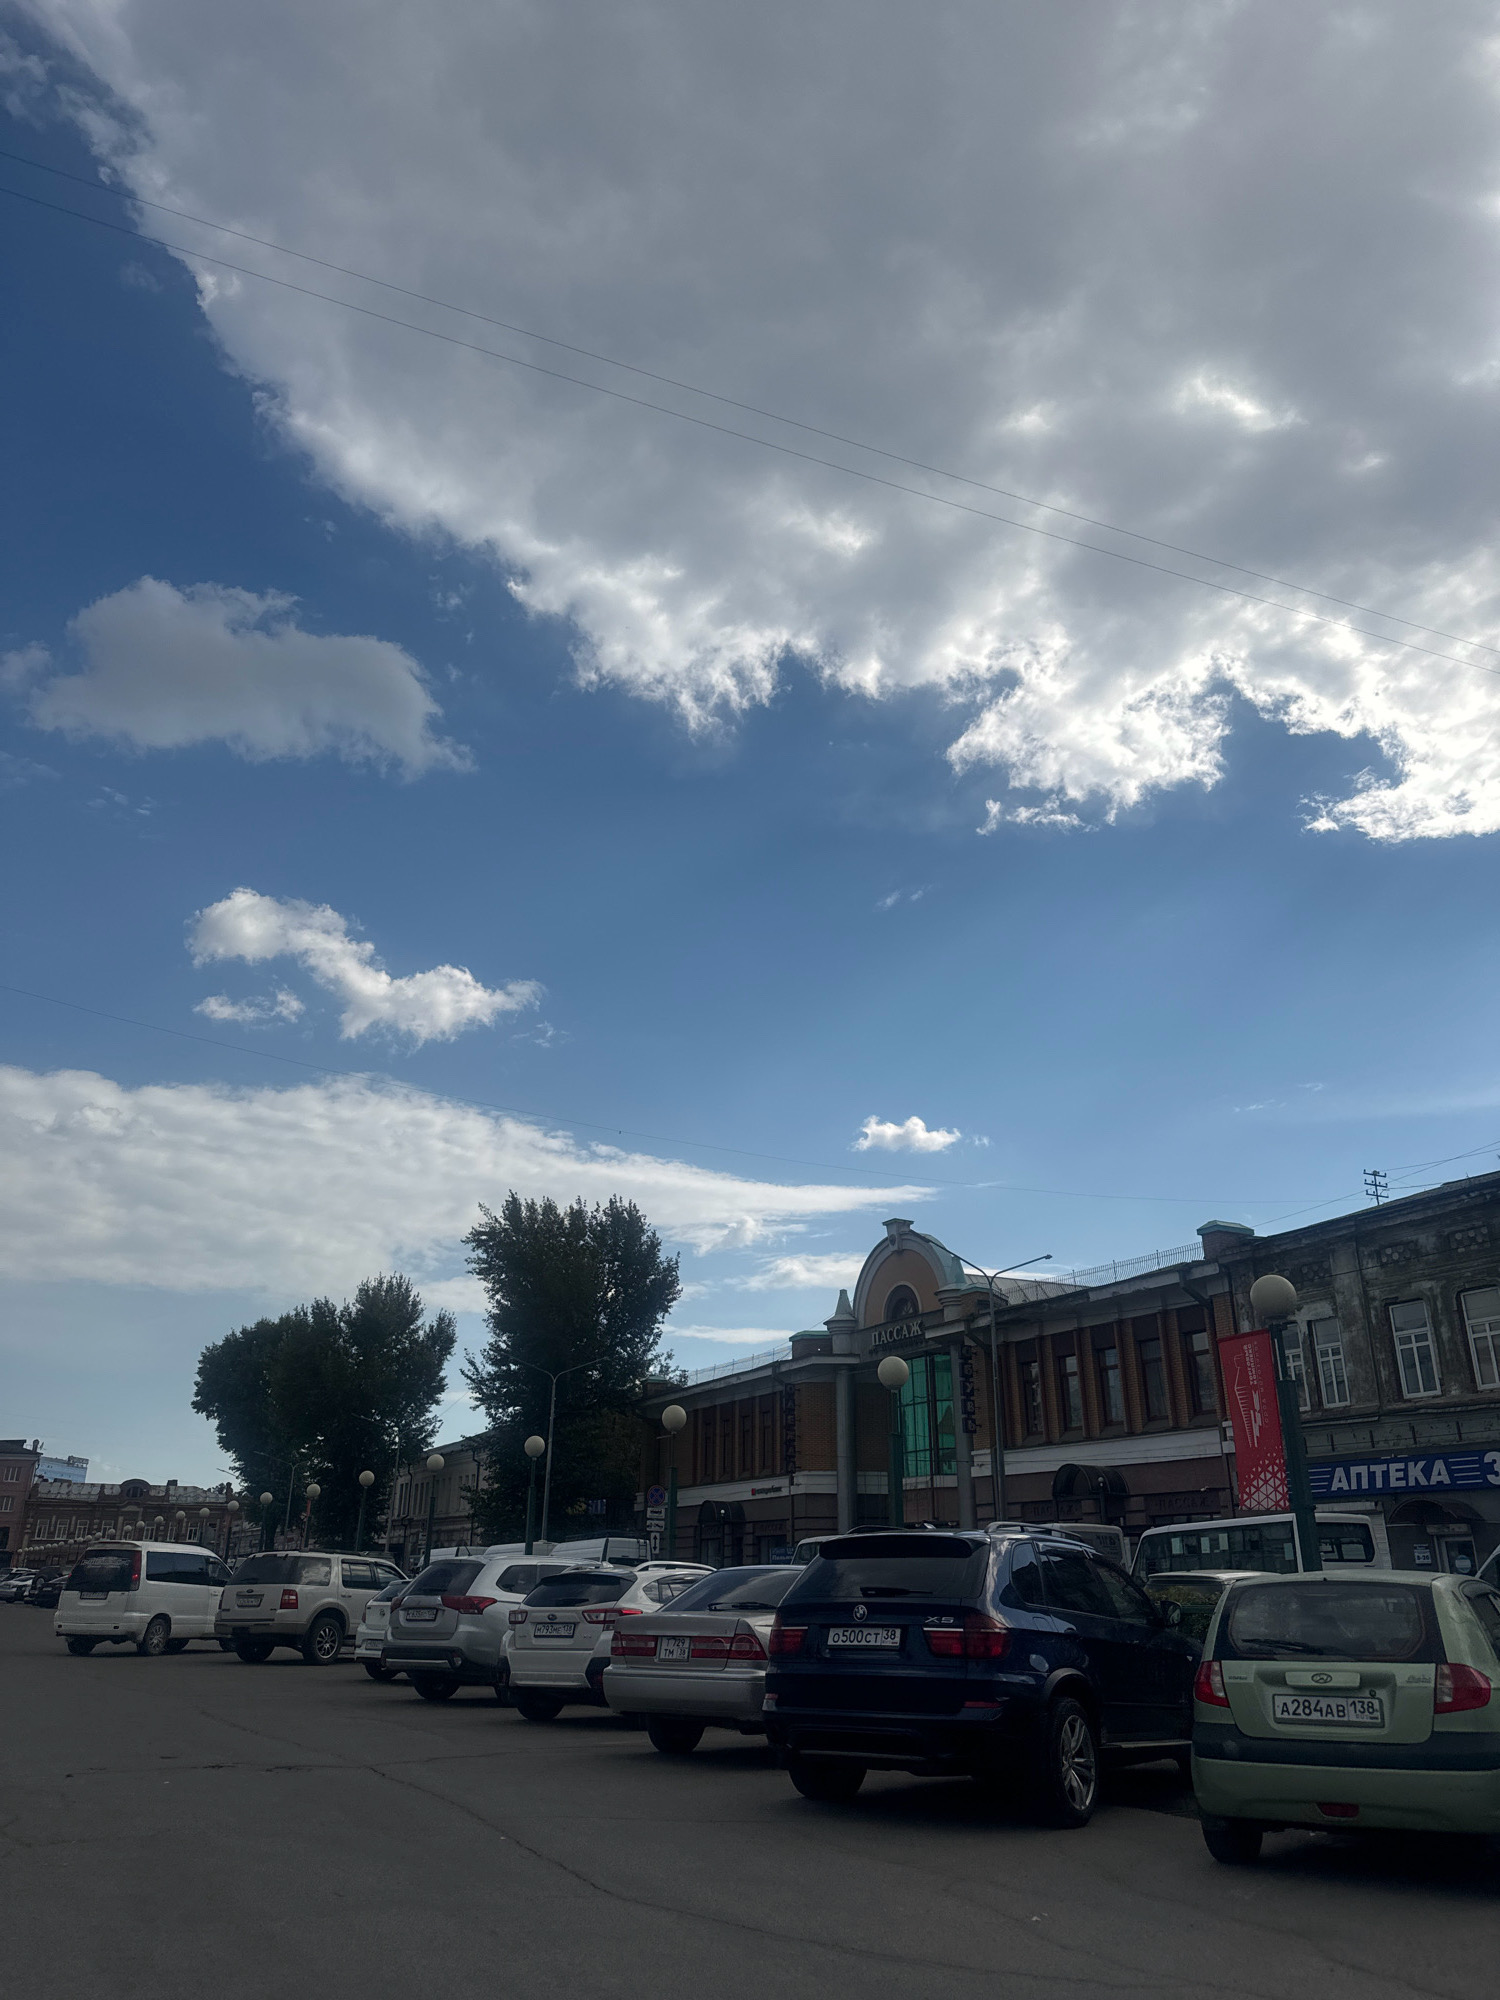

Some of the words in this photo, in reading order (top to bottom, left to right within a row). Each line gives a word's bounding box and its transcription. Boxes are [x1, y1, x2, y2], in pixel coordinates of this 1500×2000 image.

[872, 1320, 922, 1346] ПАССАЖ
[1331, 1458, 1451, 1492] АПТЕКА
[924, 1616, 955, 1624] X5
[883, 1629, 897, 1640] 38
[1280, 1699, 1347, 1718] А284АВ
[1350, 1700, 1376, 1715] 138
